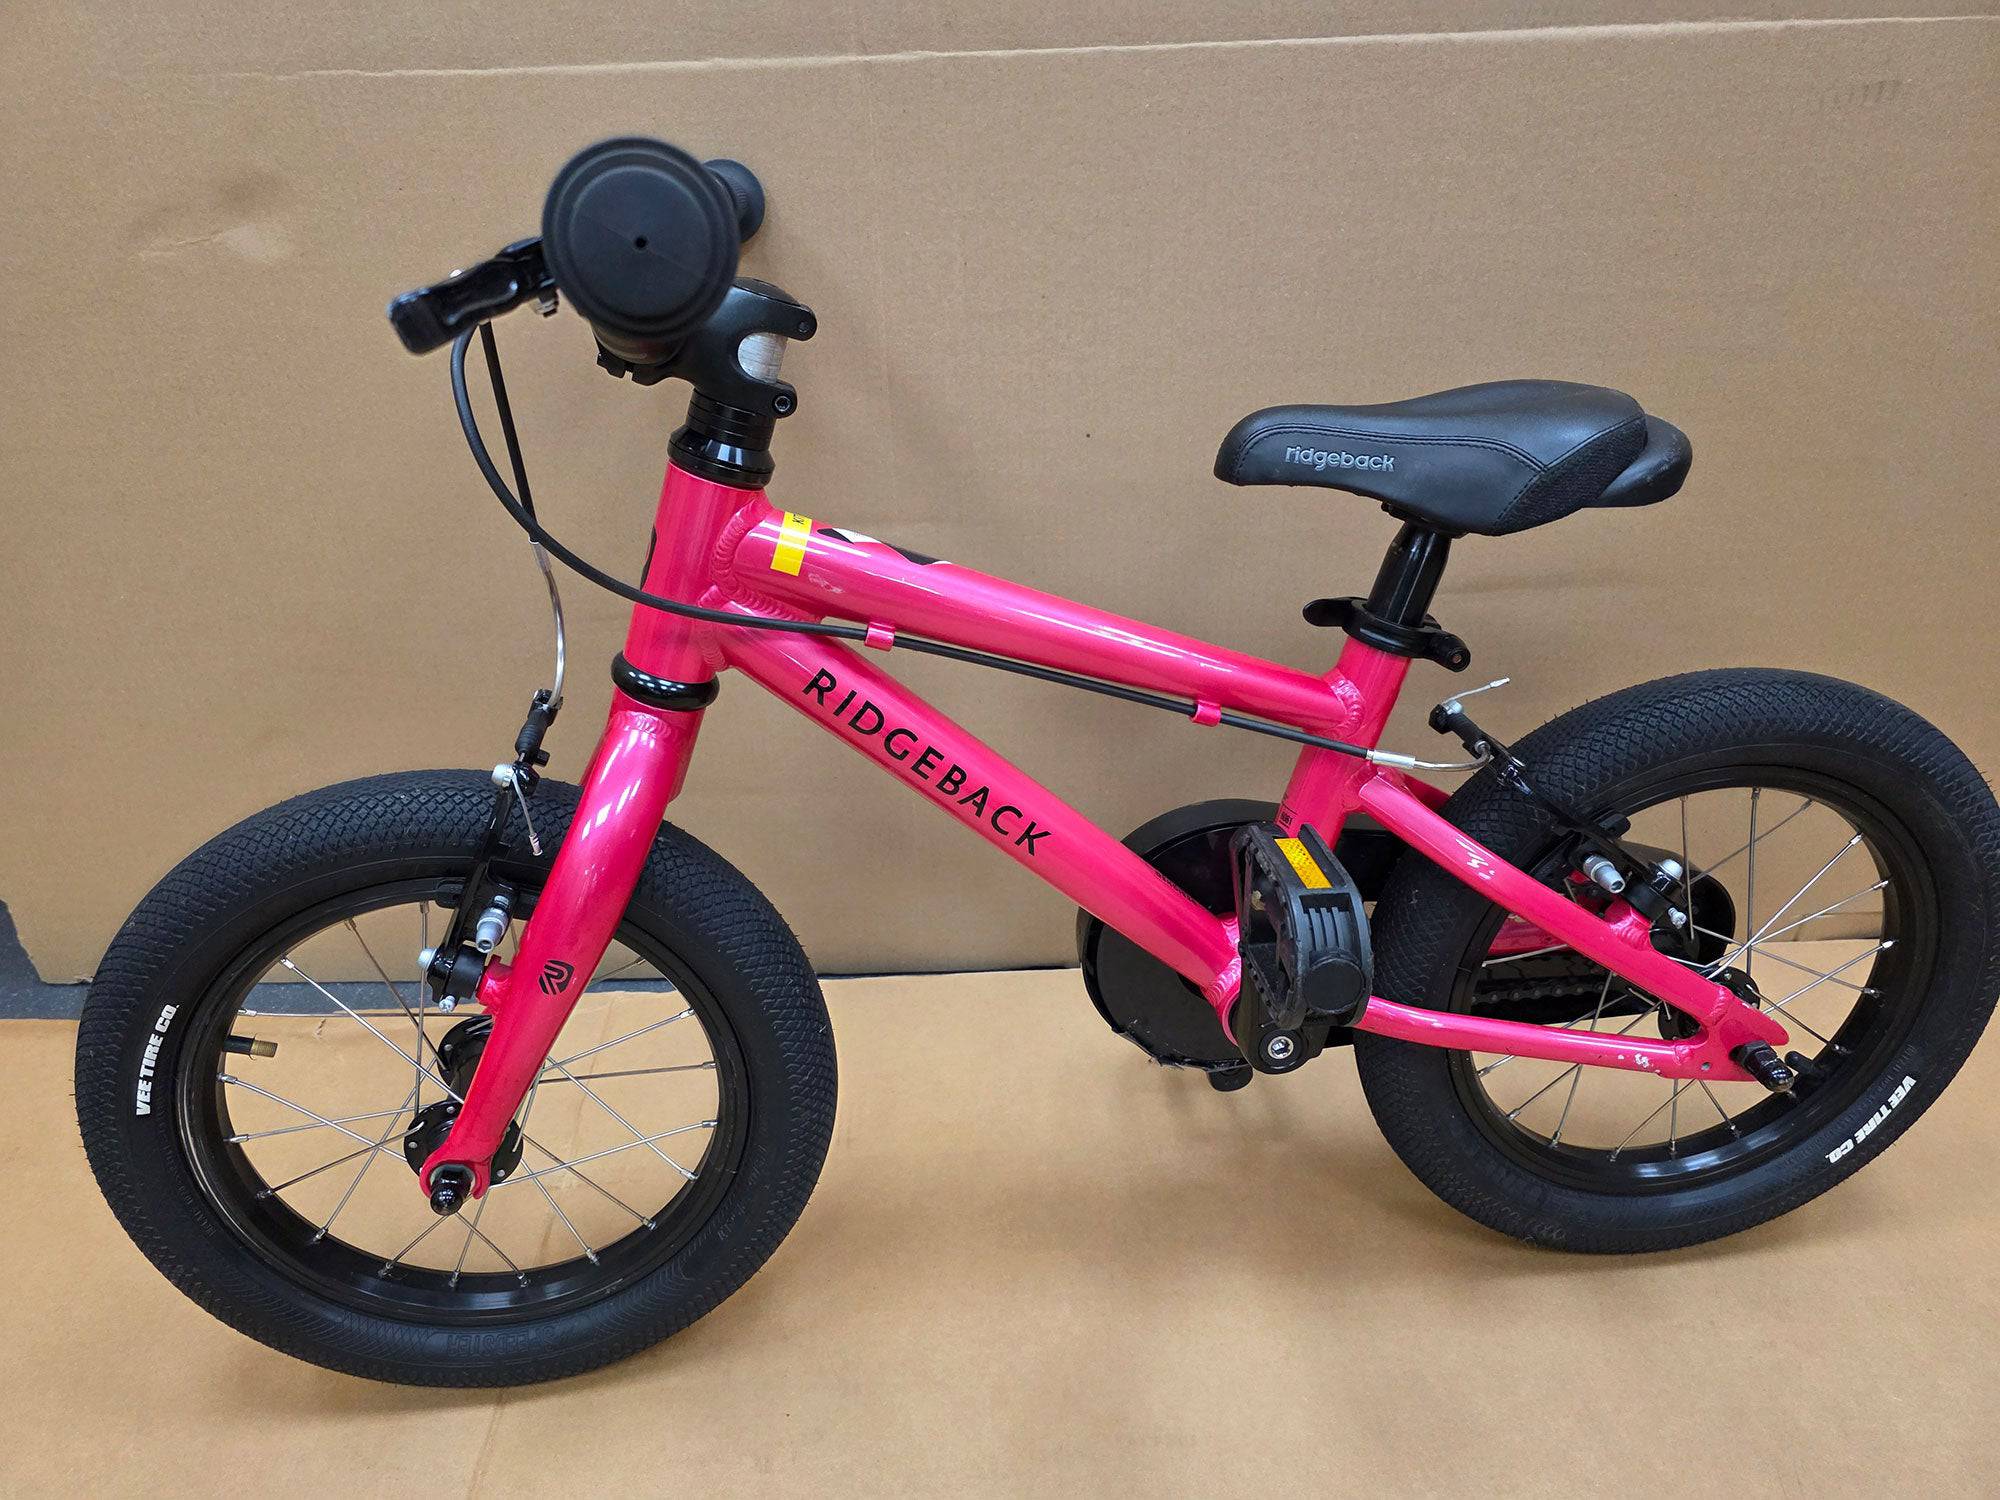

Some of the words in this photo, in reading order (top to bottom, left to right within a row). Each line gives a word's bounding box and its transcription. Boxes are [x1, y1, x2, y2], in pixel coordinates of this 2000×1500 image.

[1285, 446, 1395, 472] ridgeback
[802, 668, 1052, 857] RIDGEBACK
[155, 1004, 180, 1033] CO.
[140, 1033, 164, 1078] TIRE
[136, 1079, 152, 1116] VEE
[1887, 1075, 1917, 1109] VEE
[1854, 1104, 1892, 1144] TIRE
[1825, 1138, 1854, 1164] CO.
